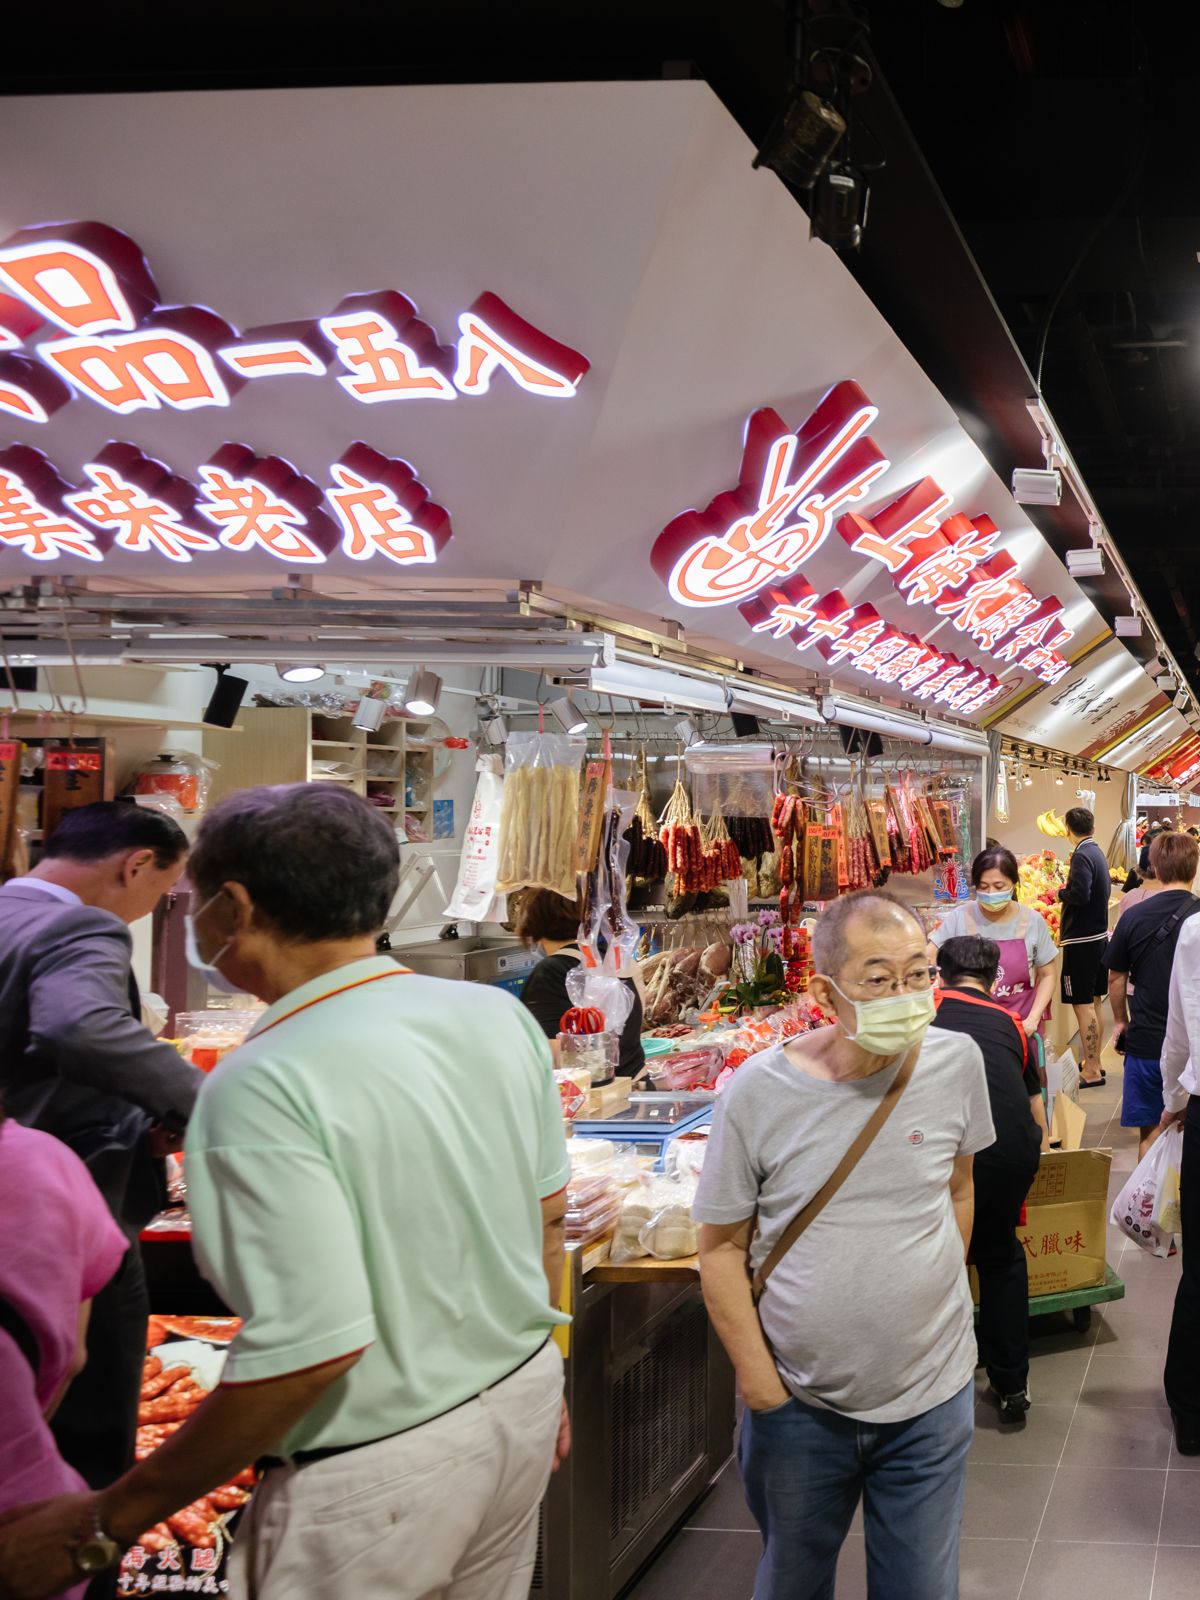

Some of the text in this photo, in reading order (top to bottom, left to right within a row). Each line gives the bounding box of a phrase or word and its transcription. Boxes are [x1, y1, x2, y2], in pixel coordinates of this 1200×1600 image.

[0, 240, 578, 420] 品一五八
[0, 462, 437, 565] 美味老店
